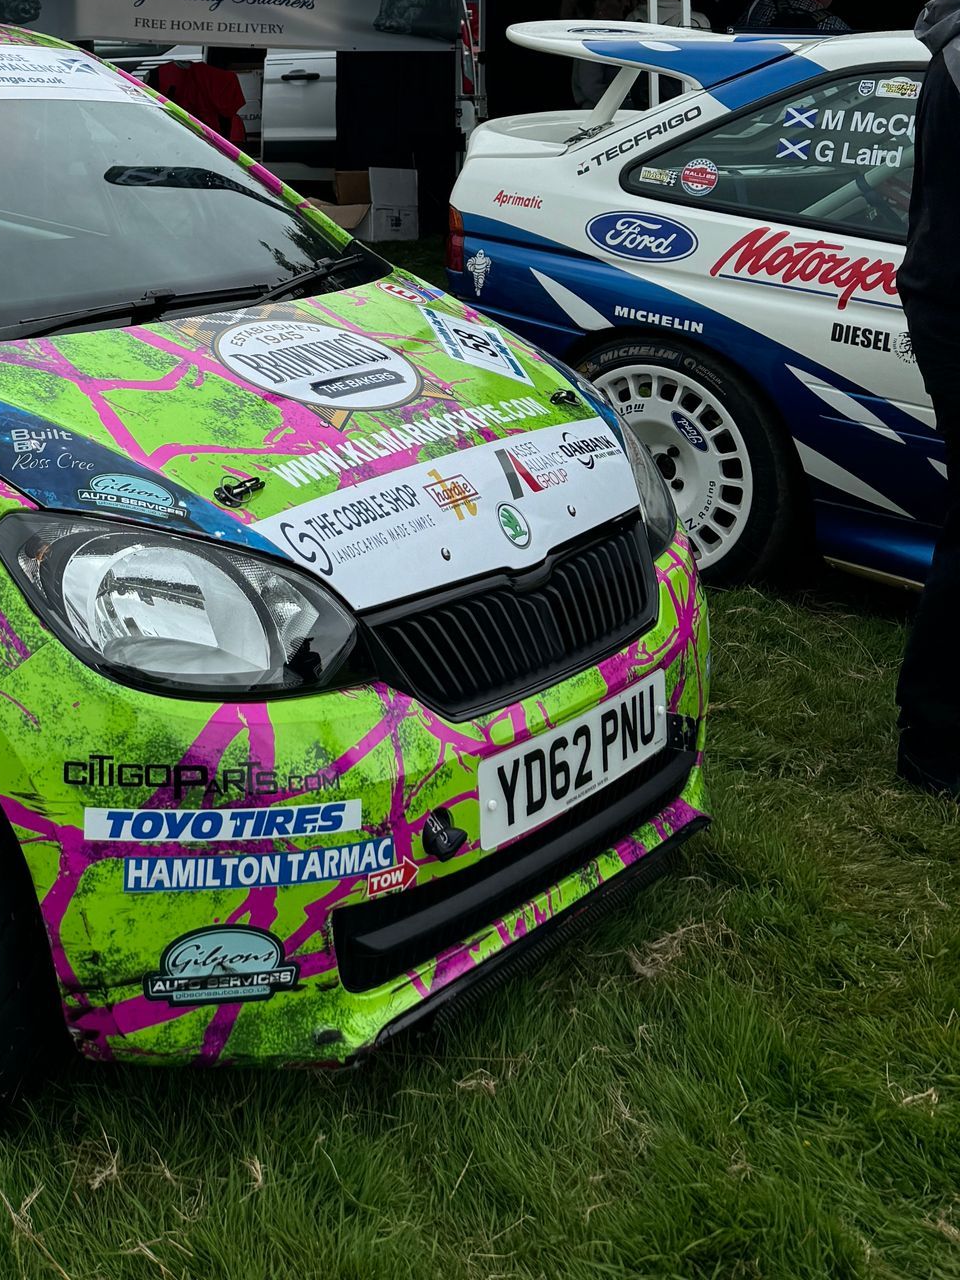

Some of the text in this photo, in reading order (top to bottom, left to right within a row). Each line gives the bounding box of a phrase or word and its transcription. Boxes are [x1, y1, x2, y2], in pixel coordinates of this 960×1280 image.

[134, 17, 285, 36] FREE HOME DELIVERY
[820, 110, 845, 130] M
[591, 105, 702, 167] TECFRIGO
[814, 142, 903, 167] G Laird
[493, 190, 543, 210] Aprimatic
[606, 217, 899, 310] Ford Motorspo
[614, 305, 704, 334] MICHELIN
[230, 324, 320, 347] ESTABLISHED
[256, 331, 304, 346] 1945
[453, 328, 499, 358] 58
[831, 322, 891, 352] DIESEL
[599, 346, 679, 364] MICHELIN
[319, 372, 396, 394] THE BAKERS
[10, 429, 73, 442] Built
[273, 397, 551, 488] WWW.KILMARNOCKPIE.COM
[559, 435, 616, 458] OAKBANK
[11, 453, 95, 470] Ross Cree
[514, 442, 541, 460] ASSET
[525, 451, 567, 472] ALLIANCE
[94, 478, 171, 502] Gibsons
[536, 468, 568, 489] GROUP
[431, 481, 471, 502] hardie
[699, 481, 716, 520] Racing
[81, 492, 184, 517] AUTO SERVICES
[304, 513, 343, 541] THE
[333, 495, 391, 530] COBBLE
[380, 485, 420, 513] SHOP
[332, 514, 436, 564] LANDSCAPING MADE SIMPLE
[497, 684, 655, 826] YD62 PNU
[106, 803, 346, 839] TOYO TIRES
[128, 838, 392, 889] HAMILTON TARMAC
[371, 869, 405, 891] TOW
[171, 943, 275, 973] Gibsons
[152, 972, 291, 993] AUTO SERVICES
